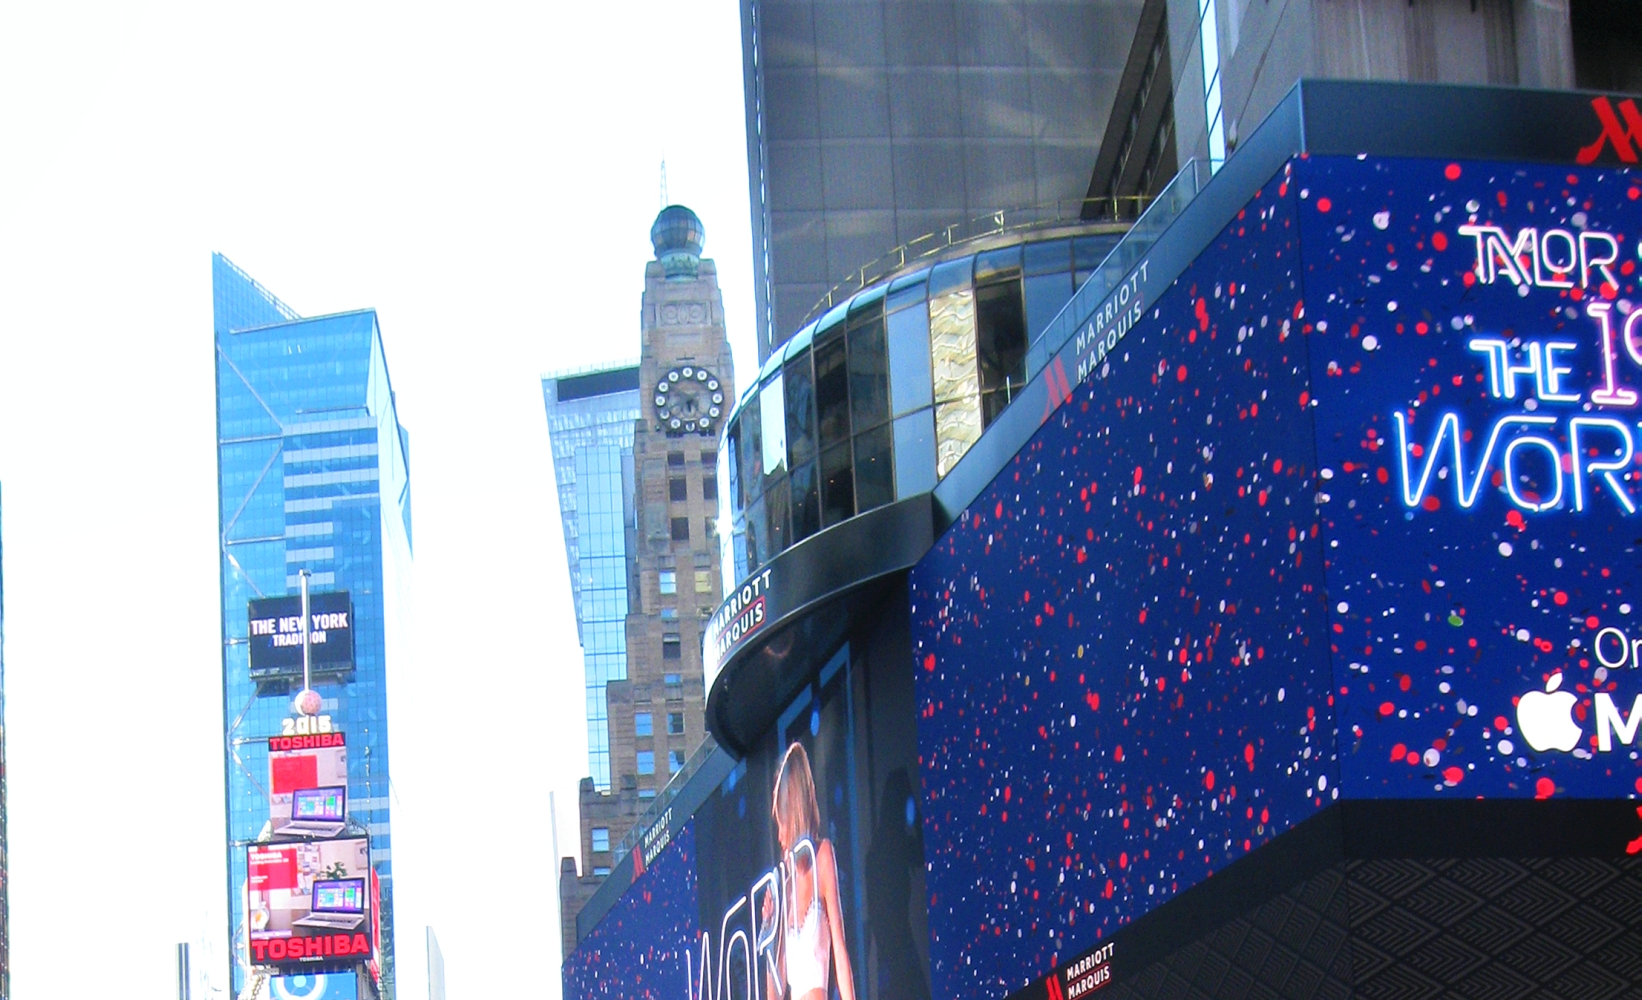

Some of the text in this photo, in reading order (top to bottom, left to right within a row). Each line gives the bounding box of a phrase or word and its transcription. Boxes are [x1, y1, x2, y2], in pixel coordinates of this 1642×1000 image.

[1077, 261, 1149, 355] MARRIOTT
[1077, 304, 1143, 379] MARQUIS
[1470, 339, 1581, 401] THE
[270, 734, 344, 750] TOSHIBA
[282, 715, 331, 736] 2015
[252, 933, 369, 960] TOSHIBA
[1067, 942, 1115, 981] MARRIOTT
[1068, 968, 1110, 1000] MARQUIS
